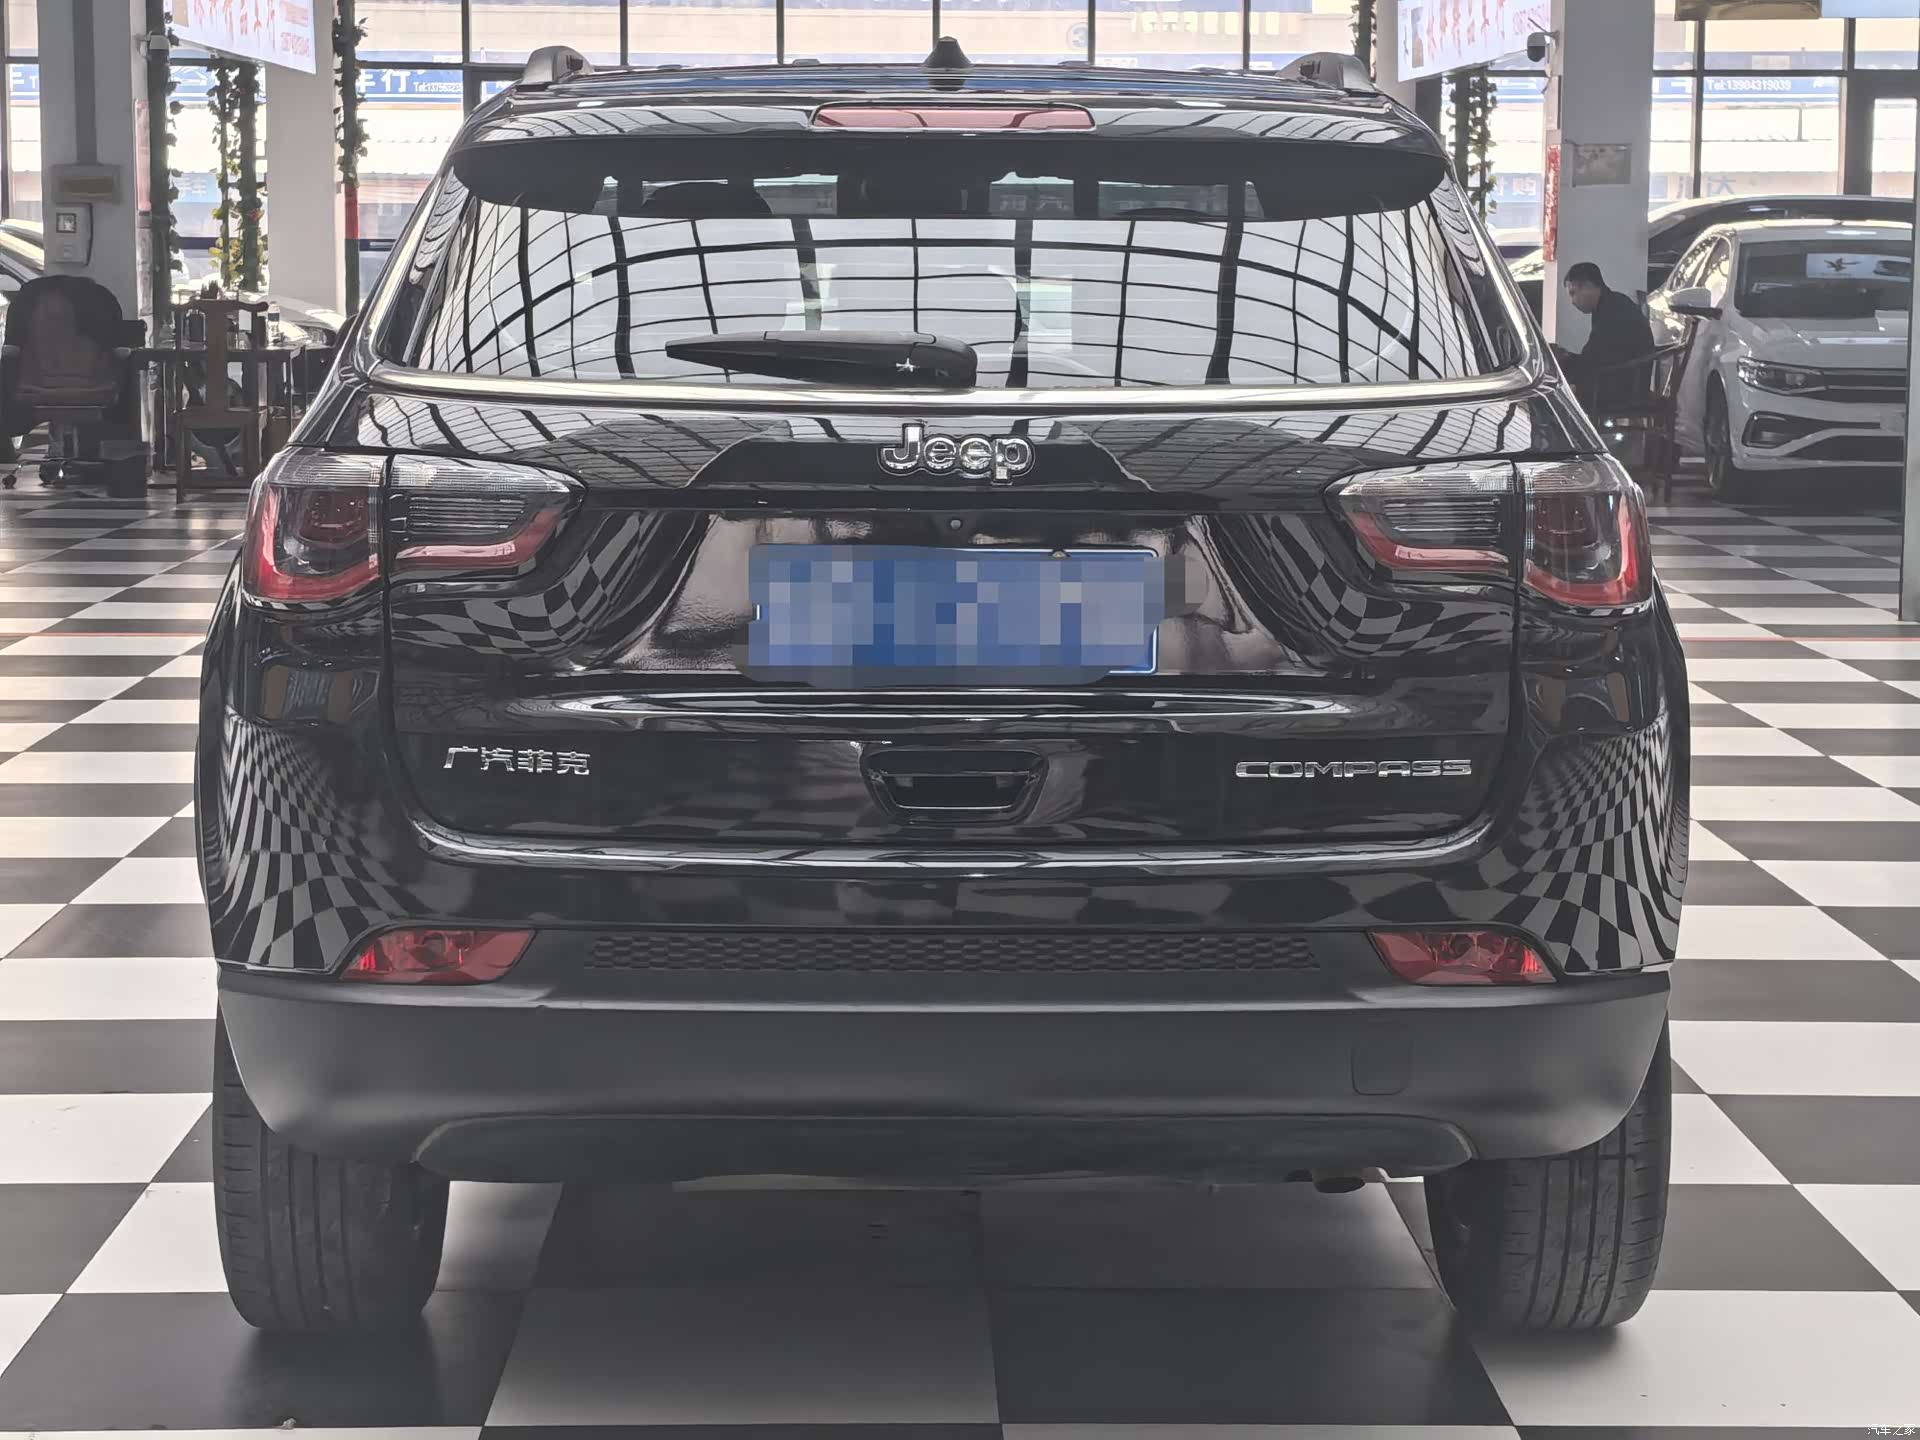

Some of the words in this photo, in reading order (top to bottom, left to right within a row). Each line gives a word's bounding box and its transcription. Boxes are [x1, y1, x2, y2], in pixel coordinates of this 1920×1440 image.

[881, 425, 1034, 481] Jeep
[443, 746, 591, 775] 广汽菲克
[1235, 759, 1473, 778] COMPASS
